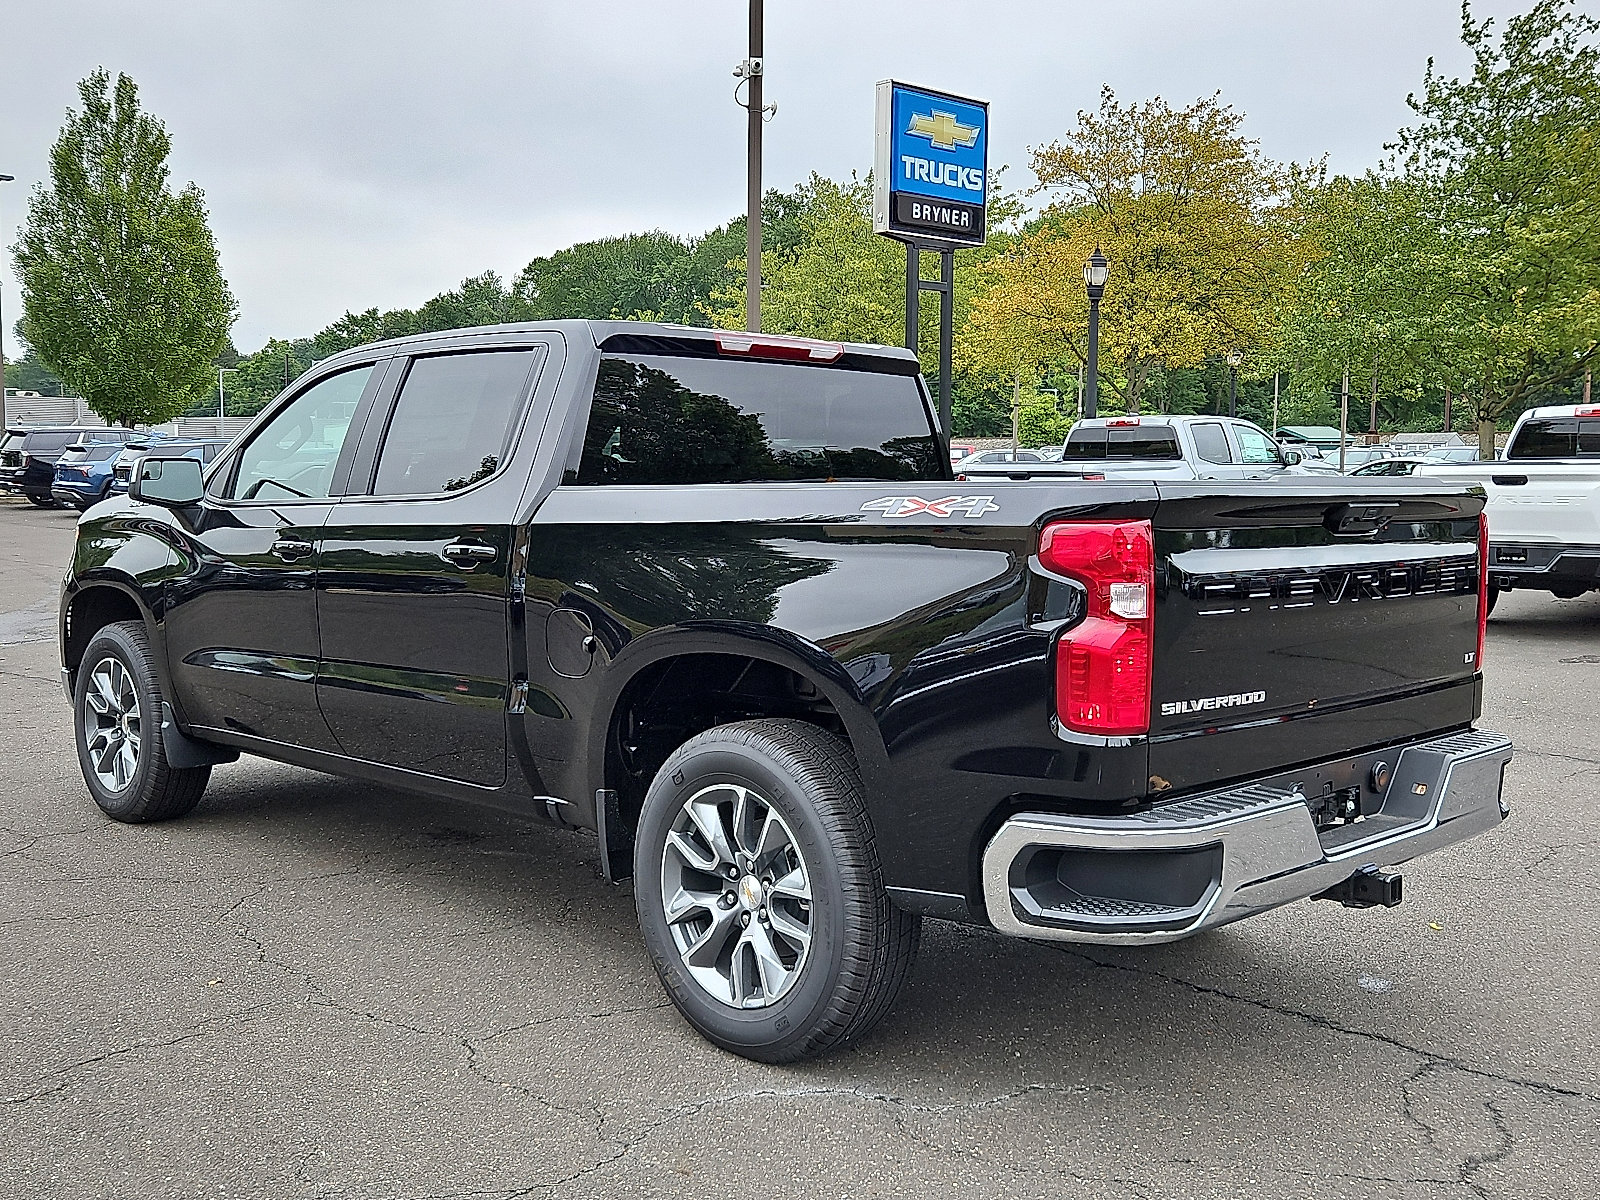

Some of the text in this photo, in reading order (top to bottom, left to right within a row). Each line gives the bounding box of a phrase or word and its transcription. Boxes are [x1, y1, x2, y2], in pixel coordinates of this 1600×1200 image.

[901, 155, 983, 191] TRUCKS
[912, 202, 969, 227] BRYNER
[860, 495, 1001, 518] 4X4
[1197, 561, 1478, 616] CHEVROLET
[1463, 651, 1476, 664] LT
[1160, 690, 1266, 716] SILVERADO
